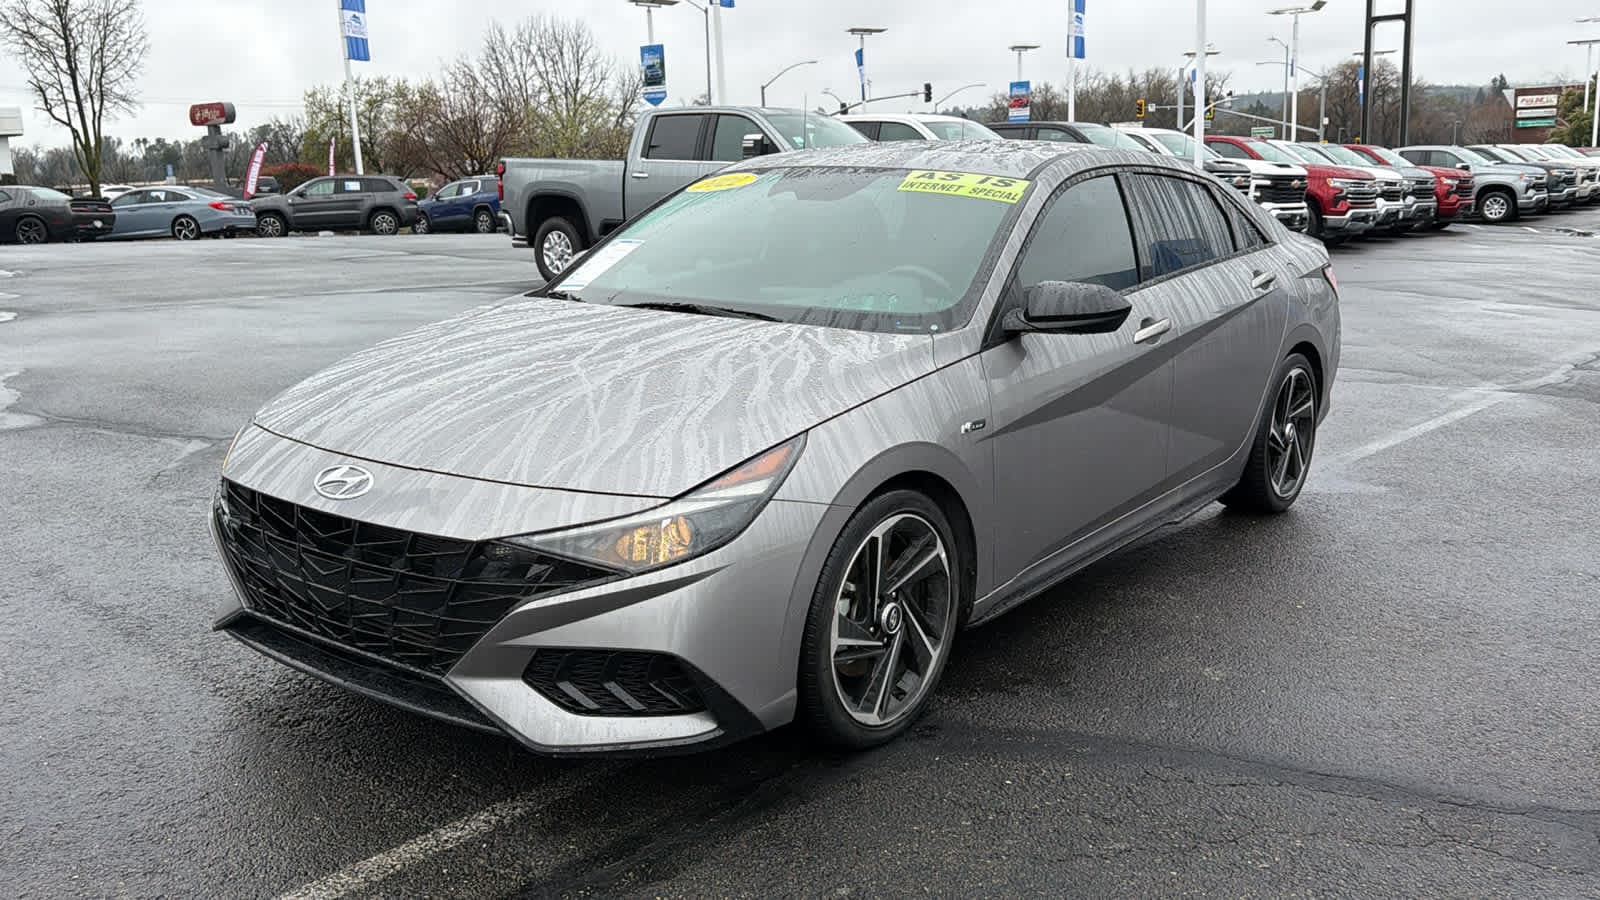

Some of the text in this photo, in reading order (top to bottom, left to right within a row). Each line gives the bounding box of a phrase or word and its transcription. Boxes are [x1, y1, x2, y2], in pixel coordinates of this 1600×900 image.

[915, 172, 1017, 188] AS IS
[903, 181, 1019, 200] INTERNET SPECIAL
